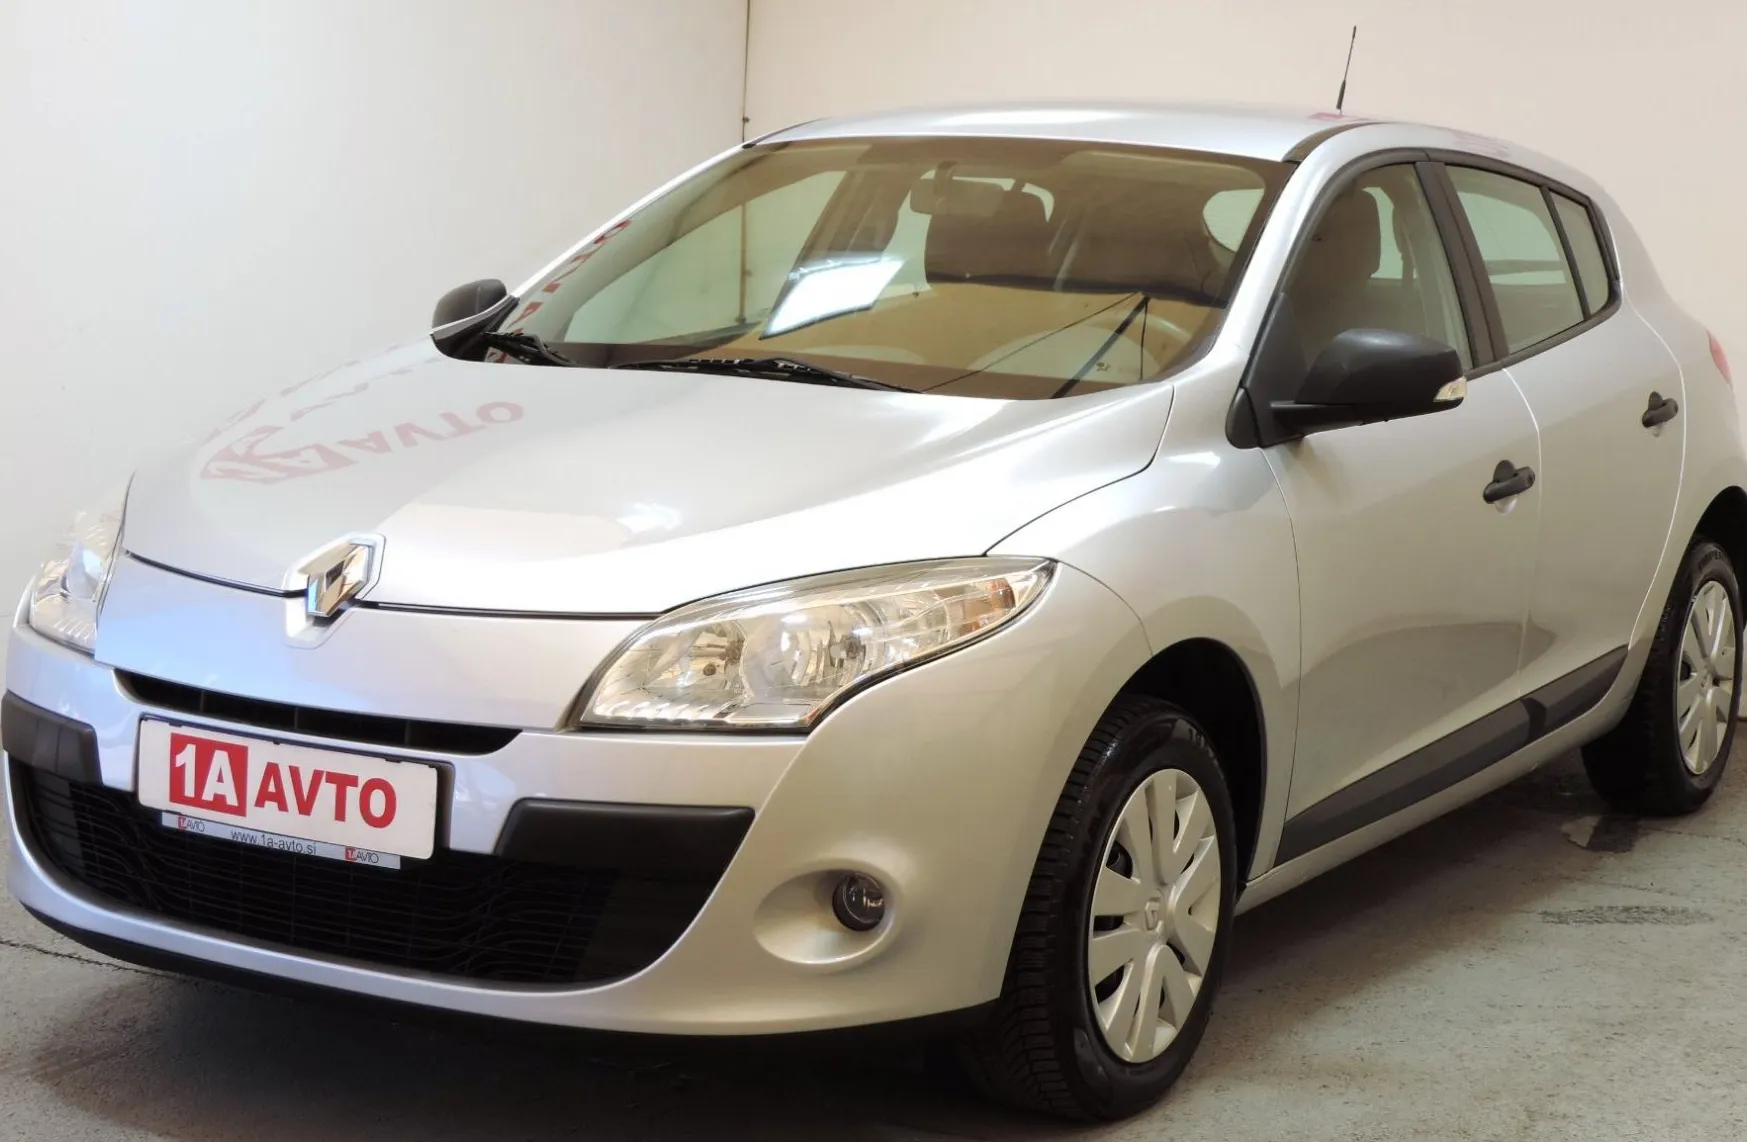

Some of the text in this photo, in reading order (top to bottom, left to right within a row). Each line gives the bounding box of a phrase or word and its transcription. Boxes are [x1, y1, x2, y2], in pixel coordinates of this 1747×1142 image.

[174, 742, 398, 829] 1A AVTO
[230, 830, 318, 855] www.1a-avto.si
